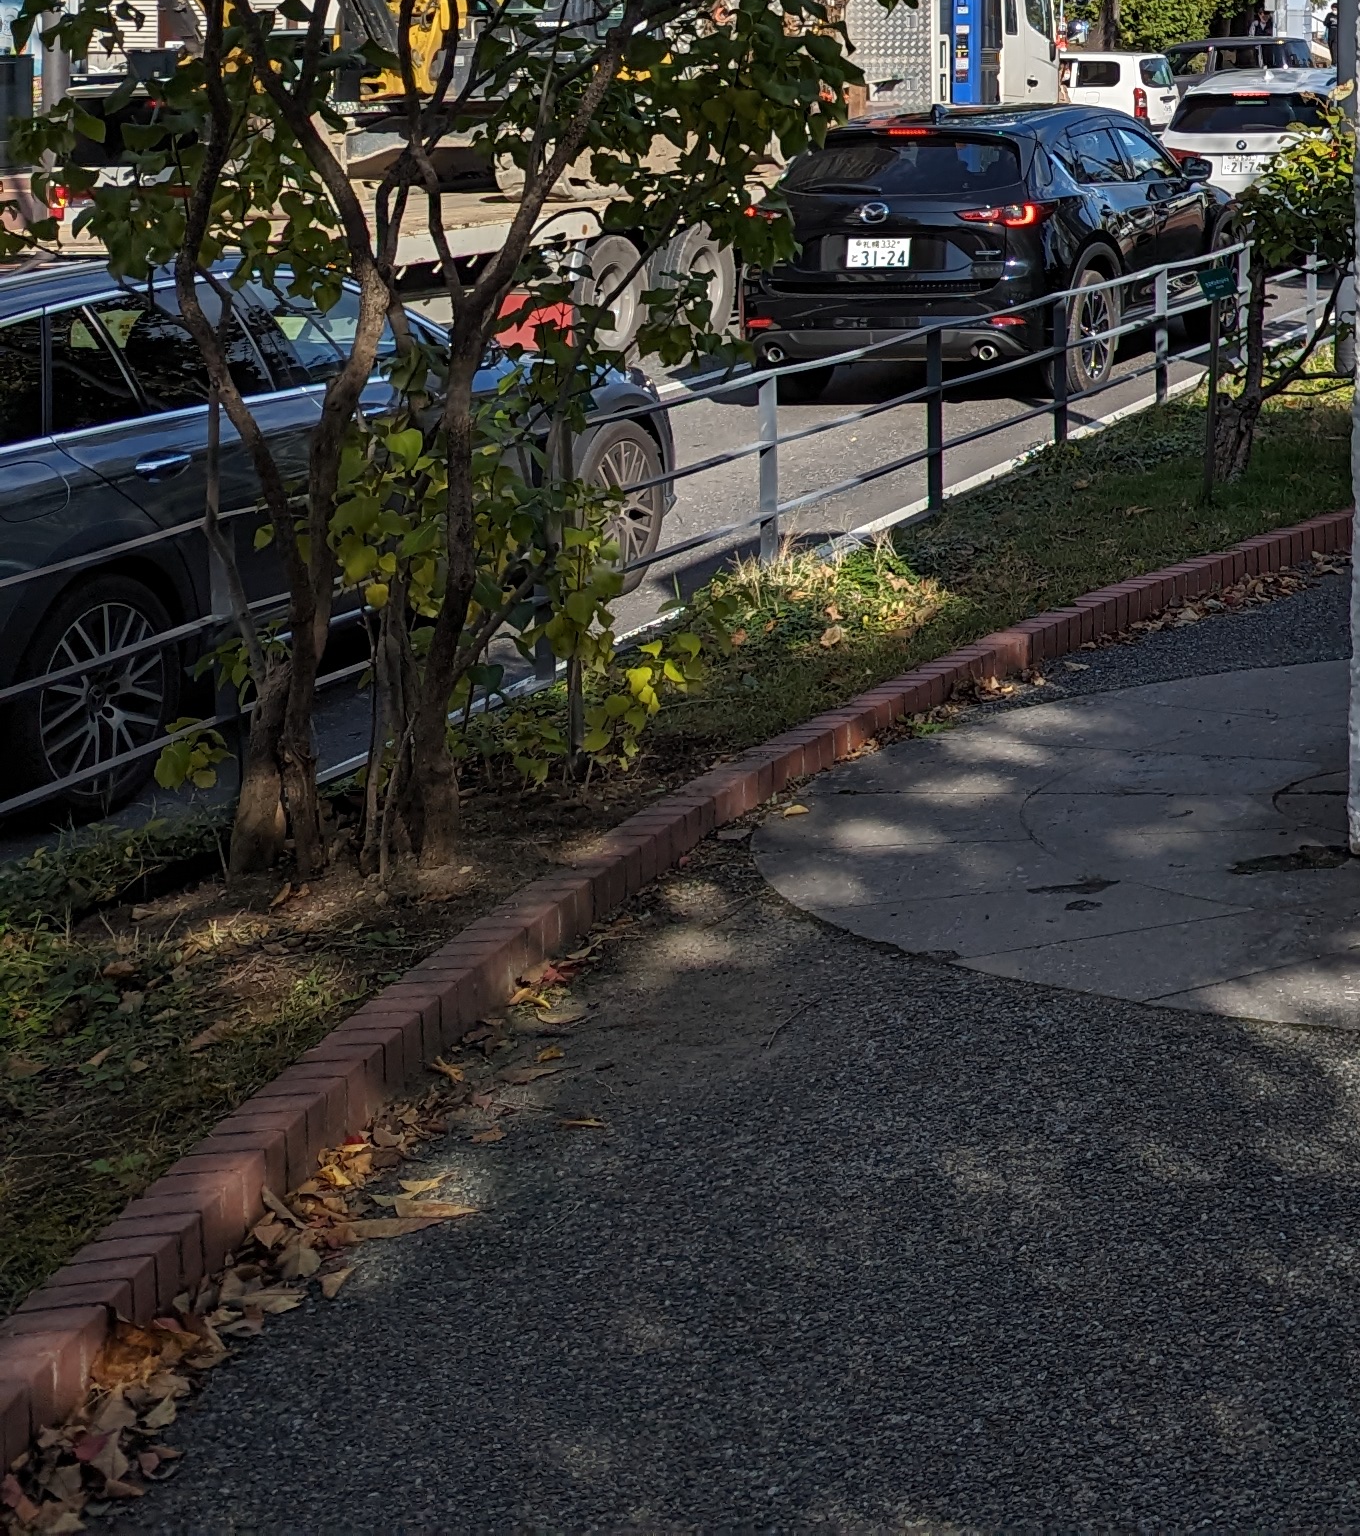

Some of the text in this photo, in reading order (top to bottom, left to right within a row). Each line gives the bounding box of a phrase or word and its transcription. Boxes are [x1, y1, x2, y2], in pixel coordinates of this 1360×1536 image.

[880, 239, 896, 249] 332
[851, 250, 905, 266] と 31-24
